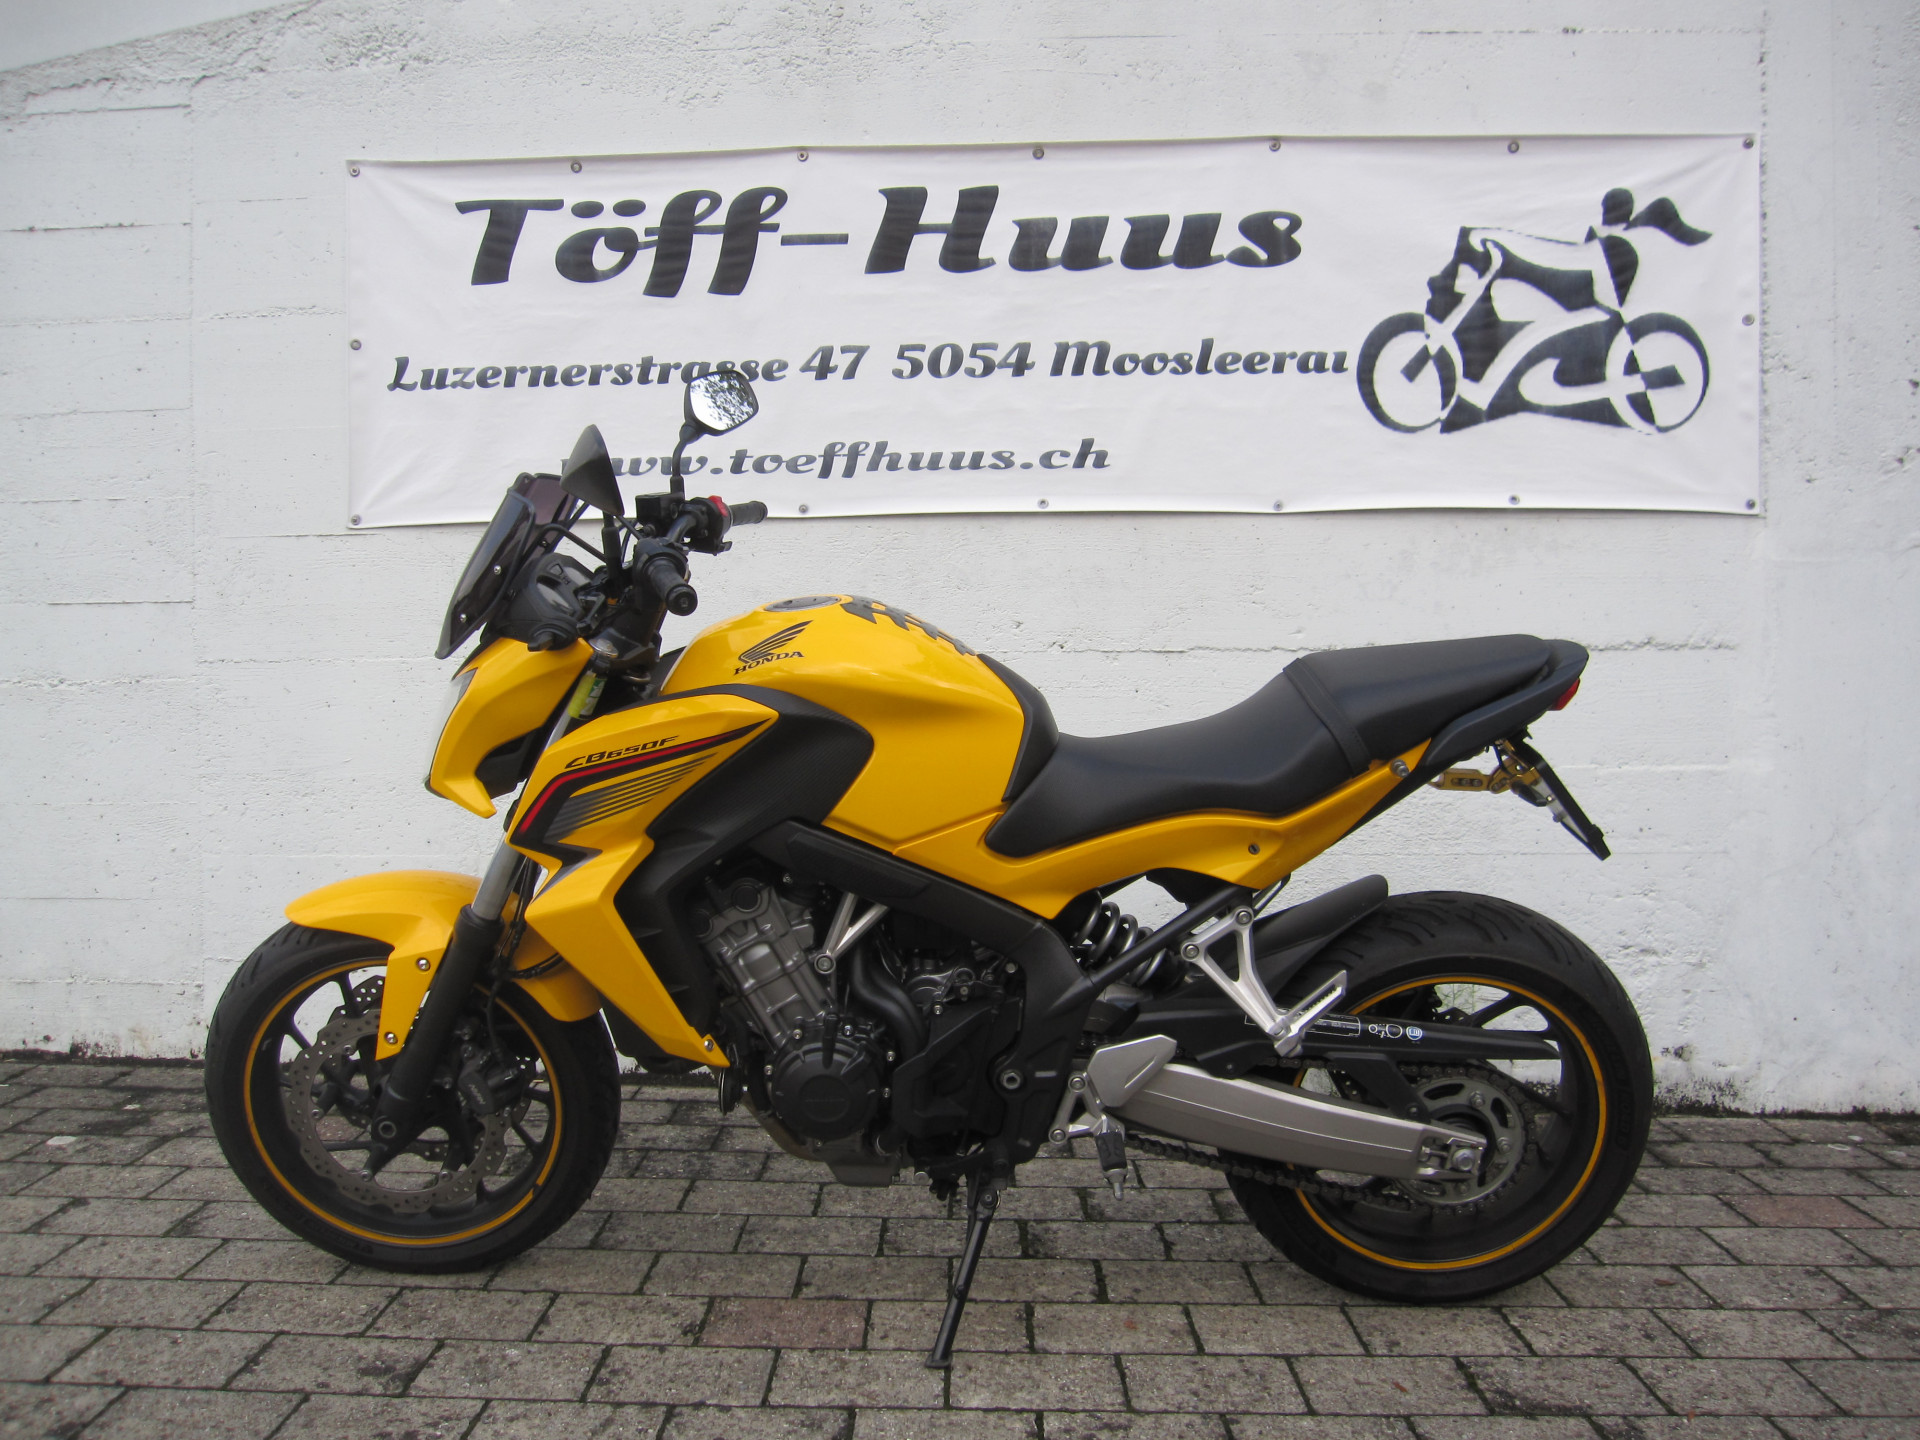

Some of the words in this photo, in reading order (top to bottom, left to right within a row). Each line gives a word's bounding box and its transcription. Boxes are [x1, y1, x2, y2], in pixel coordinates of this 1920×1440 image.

[455, 185, 1302, 298] Töff-Huus
[799, 345, 870, 381] 47
[891, 342, 1036, 380] 5054
[560, 438, 1110, 480] ww.toeffhuus.ch
[734, 651, 804, 676] HONDA
[564, 735, 679, 769] CB650F
